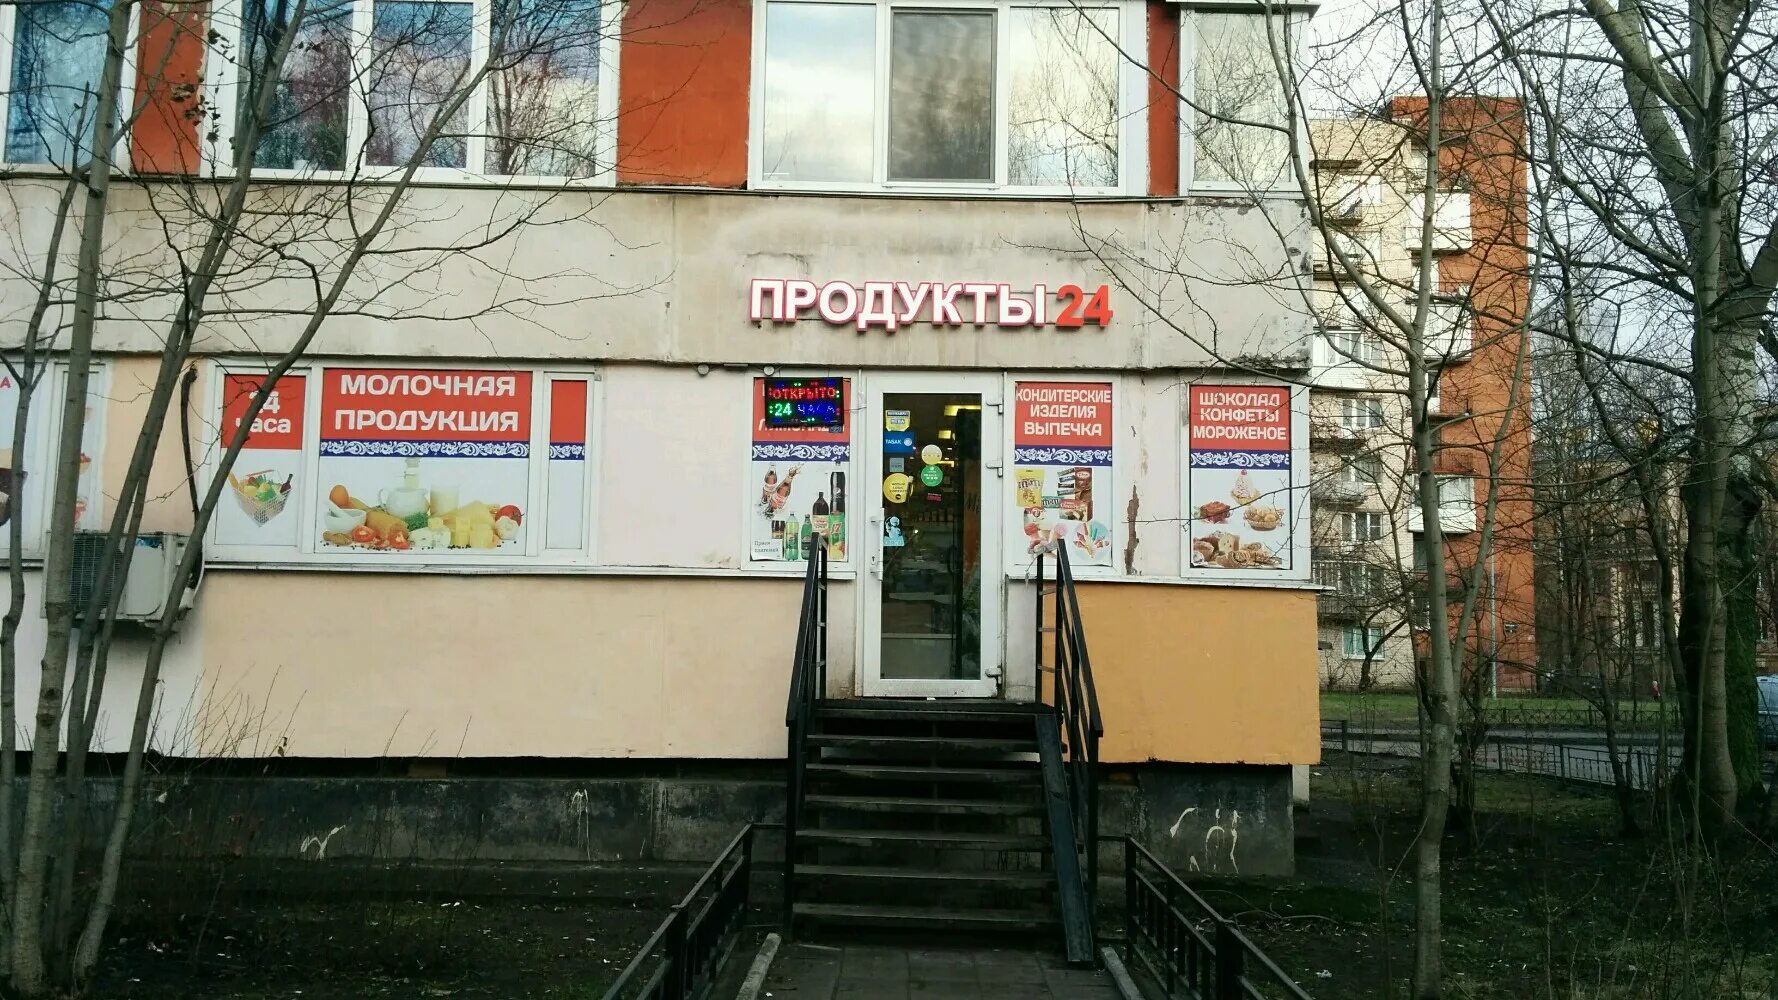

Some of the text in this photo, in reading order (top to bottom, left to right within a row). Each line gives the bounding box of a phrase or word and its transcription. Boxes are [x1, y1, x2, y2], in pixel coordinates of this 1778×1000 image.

[750, 278, 1113, 333] ПРОДУКТЫ 24
[340, 374, 515, 397] МОЛОЧНАЯ
[772, 387, 836, 400] ОТКРЫТО
[1016, 388, 1112, 404] КОНДИТЕРСКИЕ
[1199, 392, 1280, 407] ШОКОЛАД
[774, 402, 792, 417] 24
[1030, 404, 1097, 420] ИЗДЕЛИЯ
[1200, 407, 1279, 423] КОНФЕТЫ
[334, 409, 519, 432] ПРОДУКЦИЯ
[1024, 421, 1102, 437] ВЫПЕЧКА
[1193, 426, 1286, 441] МОРОЖЕНОЕ
